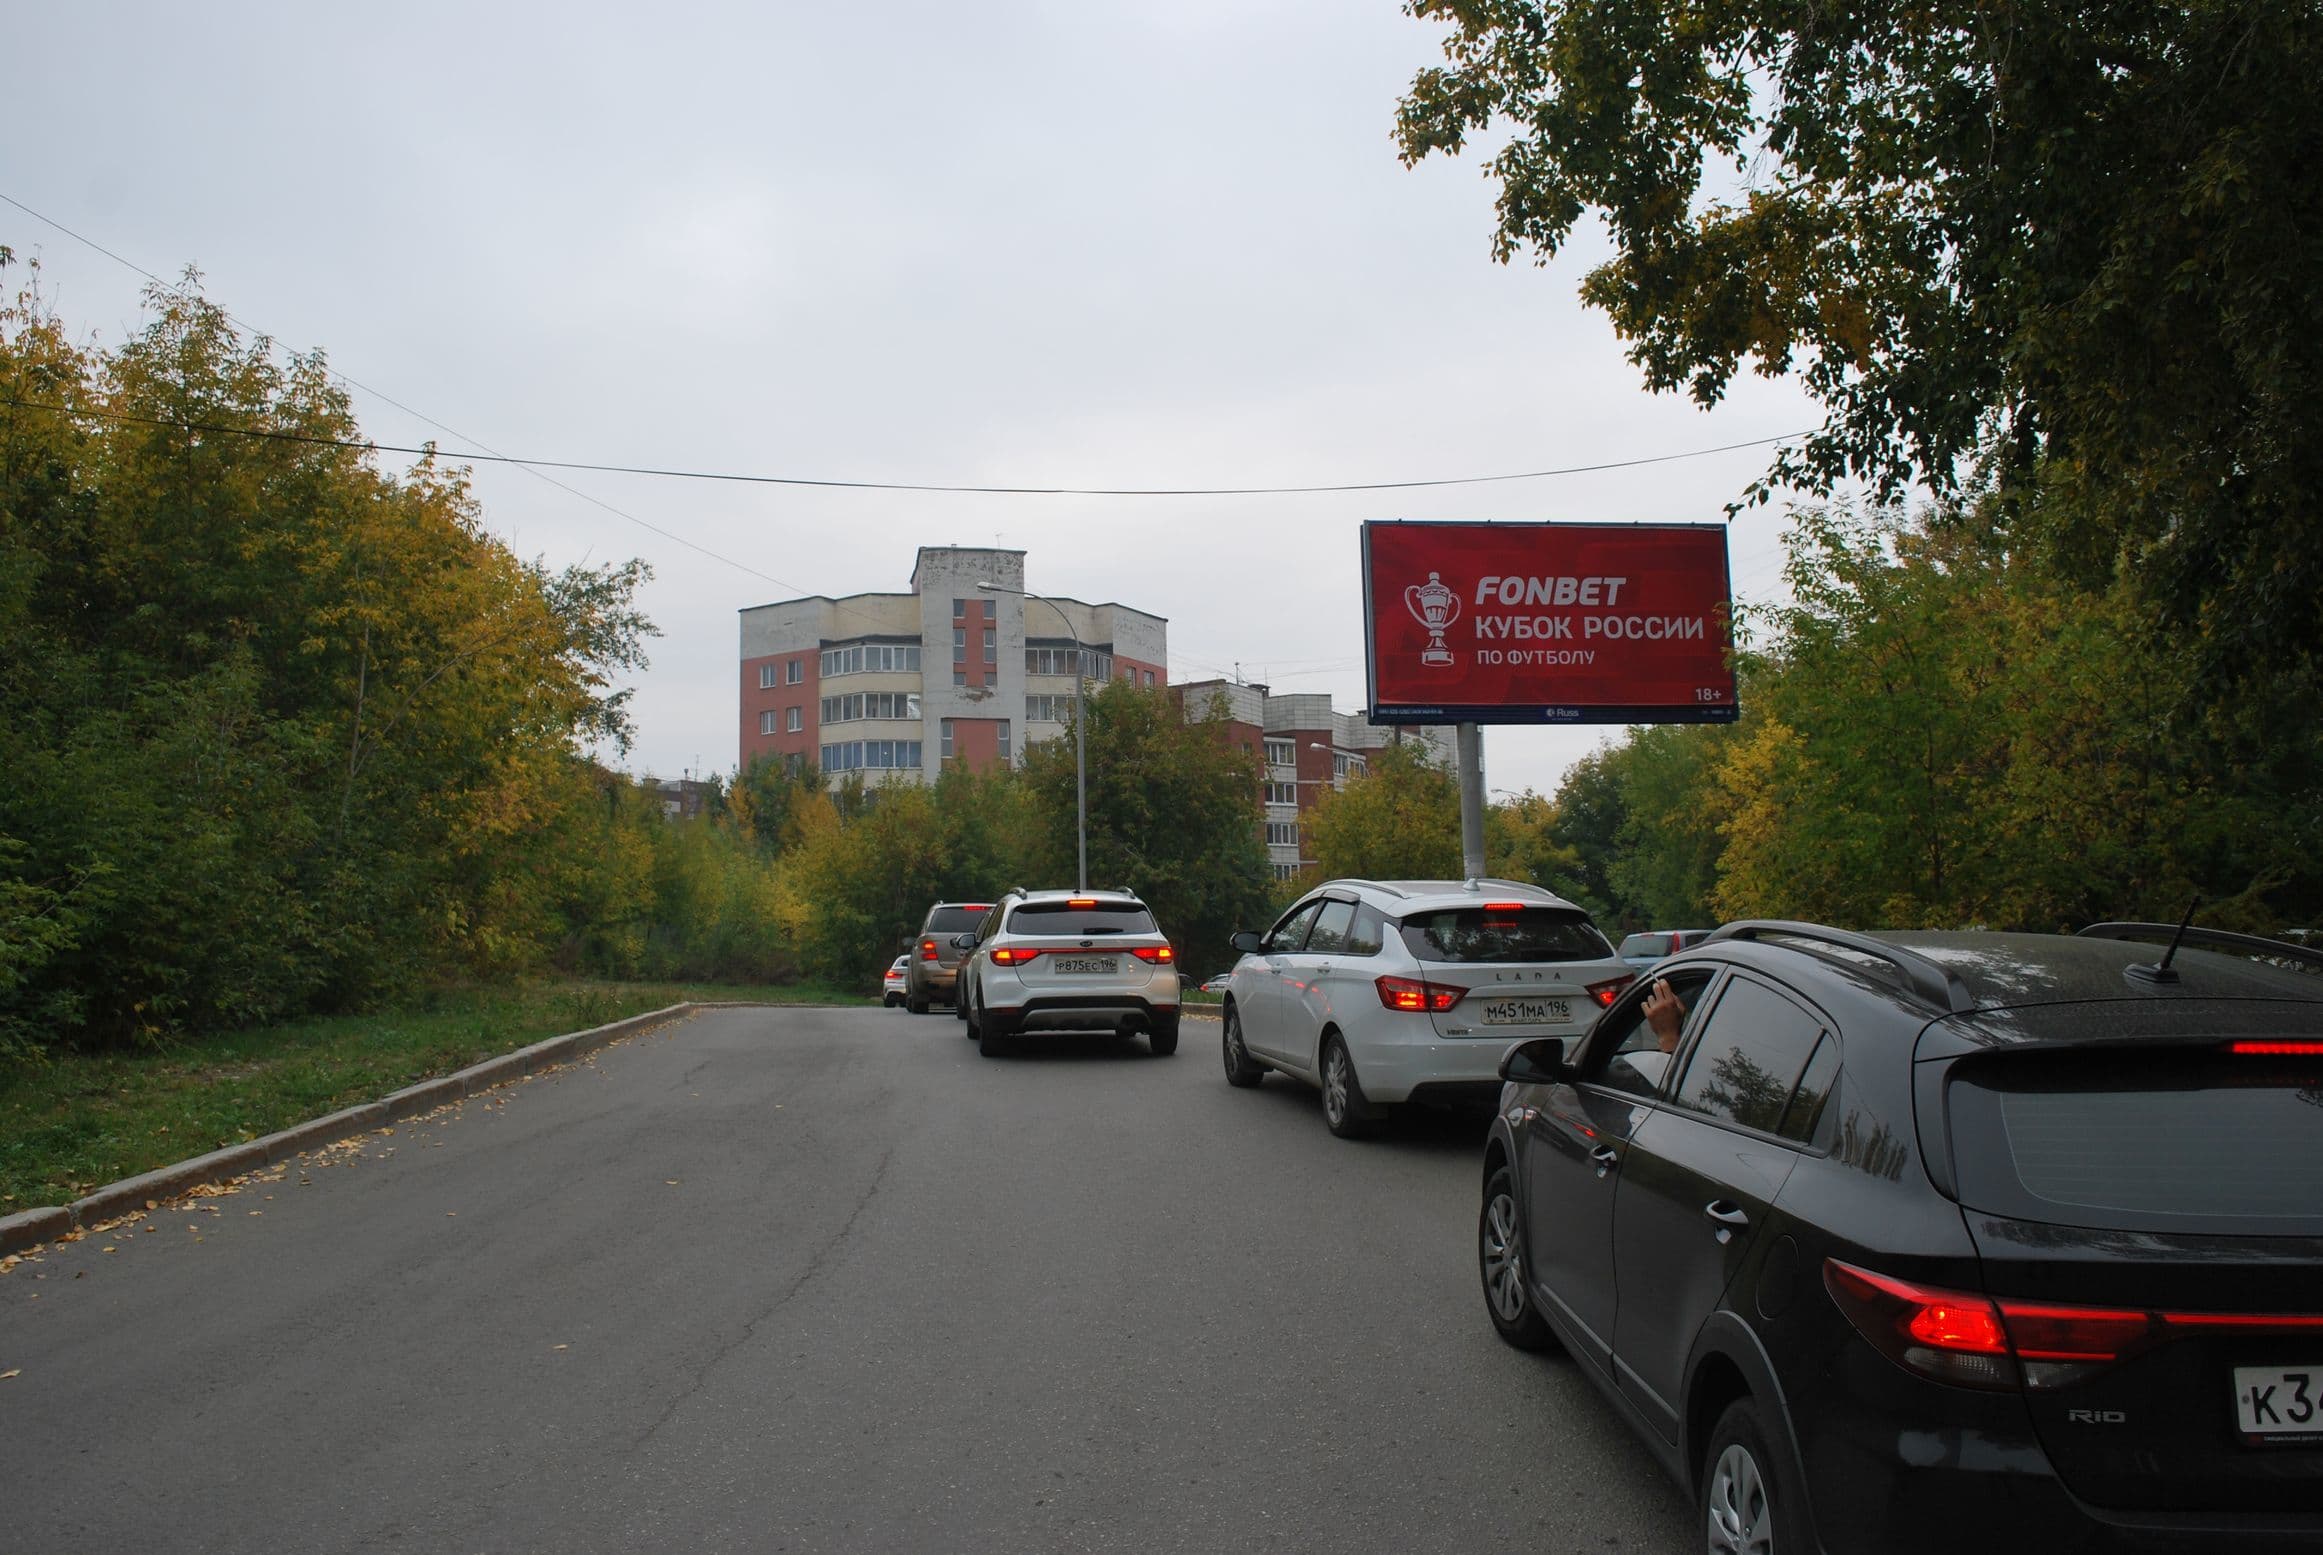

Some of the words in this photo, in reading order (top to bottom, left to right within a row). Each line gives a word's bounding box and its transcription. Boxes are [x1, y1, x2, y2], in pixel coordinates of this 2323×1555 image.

[1475, 576, 1627, 606] FONBET
[1475, 615, 1573, 639] КУБОК
[1584, 616, 1704, 640] РОССИИ
[1477, 650, 1503, 665] ПО
[1507, 649, 1595, 666] ФУТБОЛУ
[1695, 687, 1722, 701] 18+
[1547, 1000, 1569, 1013] 196
[2251, 1373, 2323, 1425] К3
